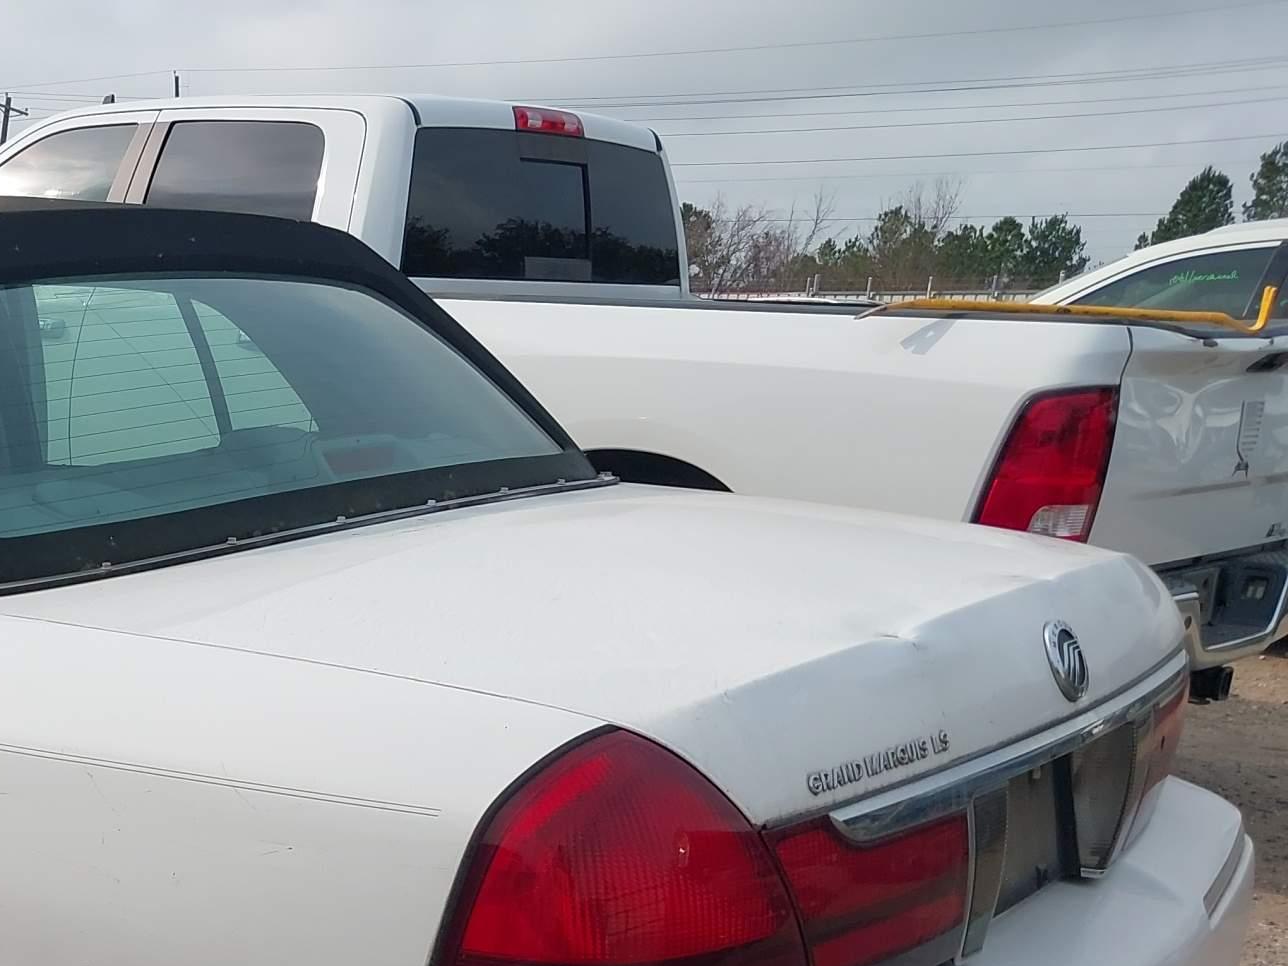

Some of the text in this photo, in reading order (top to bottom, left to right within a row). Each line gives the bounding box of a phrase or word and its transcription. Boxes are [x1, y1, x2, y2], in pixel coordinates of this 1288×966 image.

[807, 729, 950, 796] GRAND MARQUIS LS
